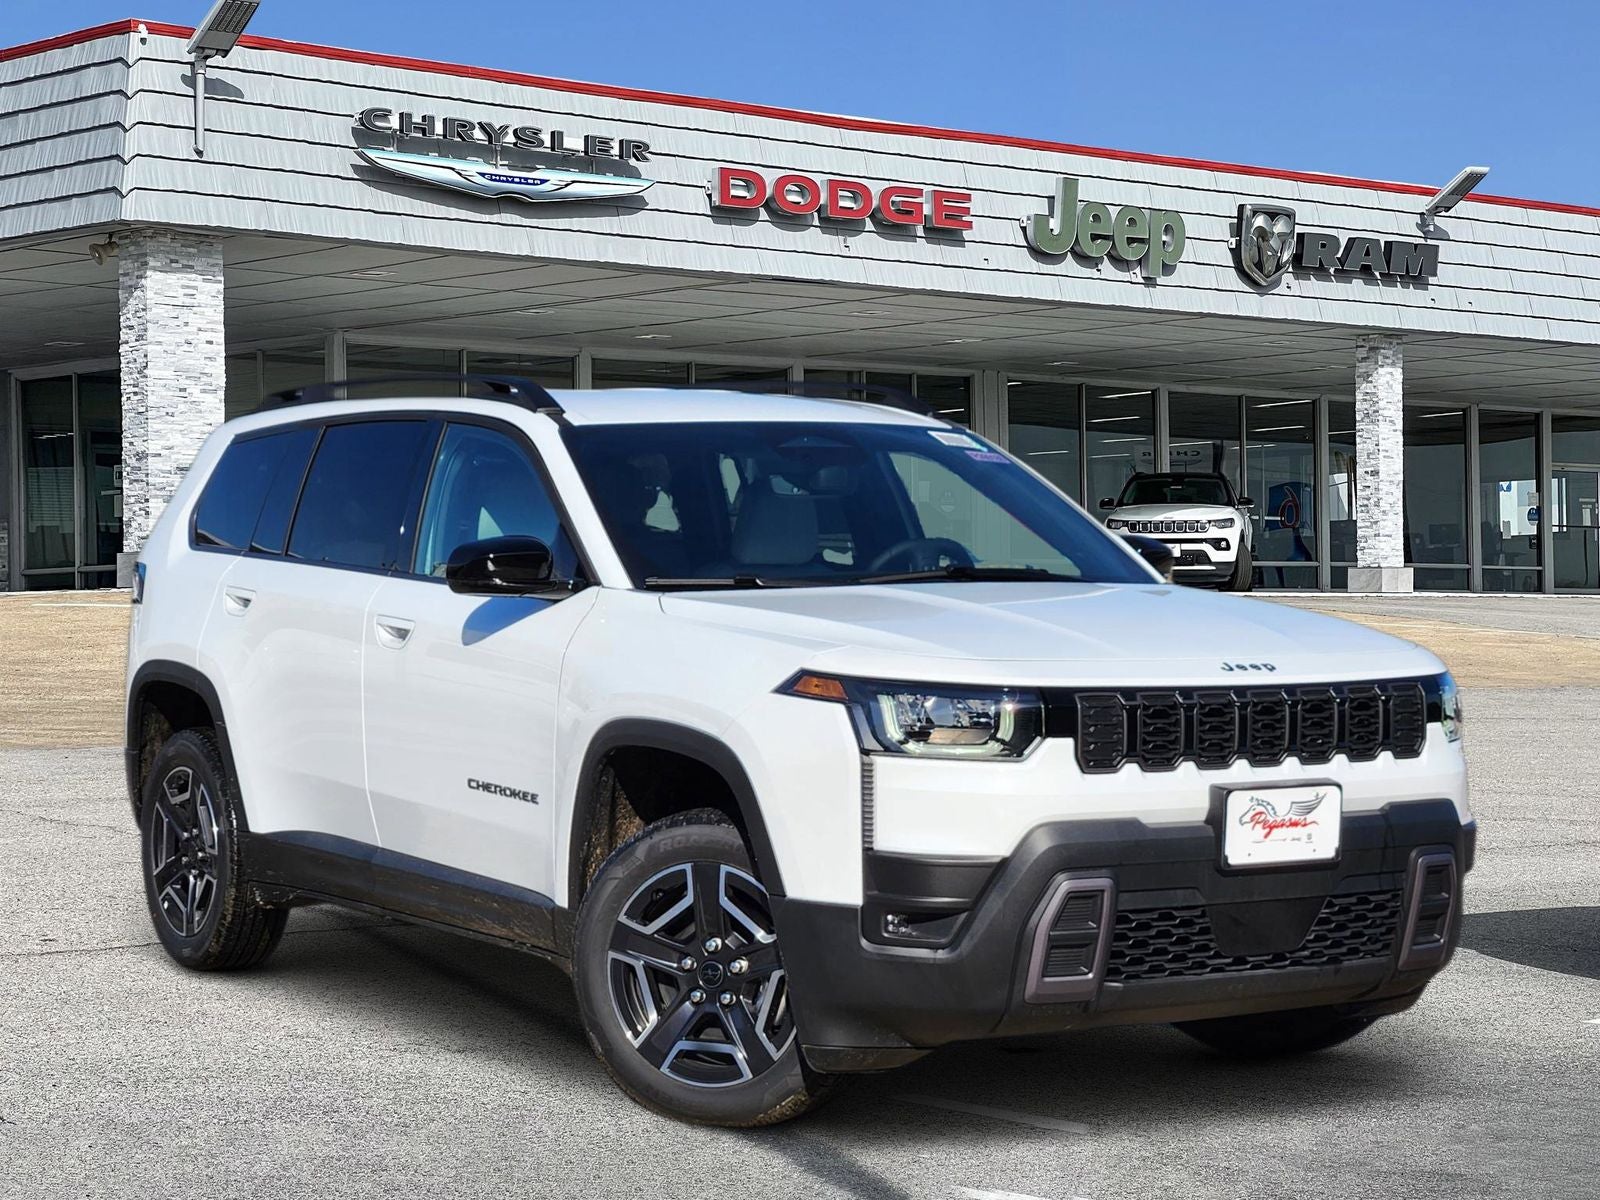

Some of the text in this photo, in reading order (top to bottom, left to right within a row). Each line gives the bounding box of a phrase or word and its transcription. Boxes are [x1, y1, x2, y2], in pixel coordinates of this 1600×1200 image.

[359, 106, 651, 162] CHRYSLER
[484, 174, 541, 184] CHRYSLER
[712, 166, 974, 231] DODGE
[1025, 176, 1186, 278] Jeep
[1295, 231, 1440, 277] RAM
[1220, 661, 1277, 673] Jeep
[467, 777, 539, 805] CHEROKEE
[1250, 811, 1319, 839] Pegasus
